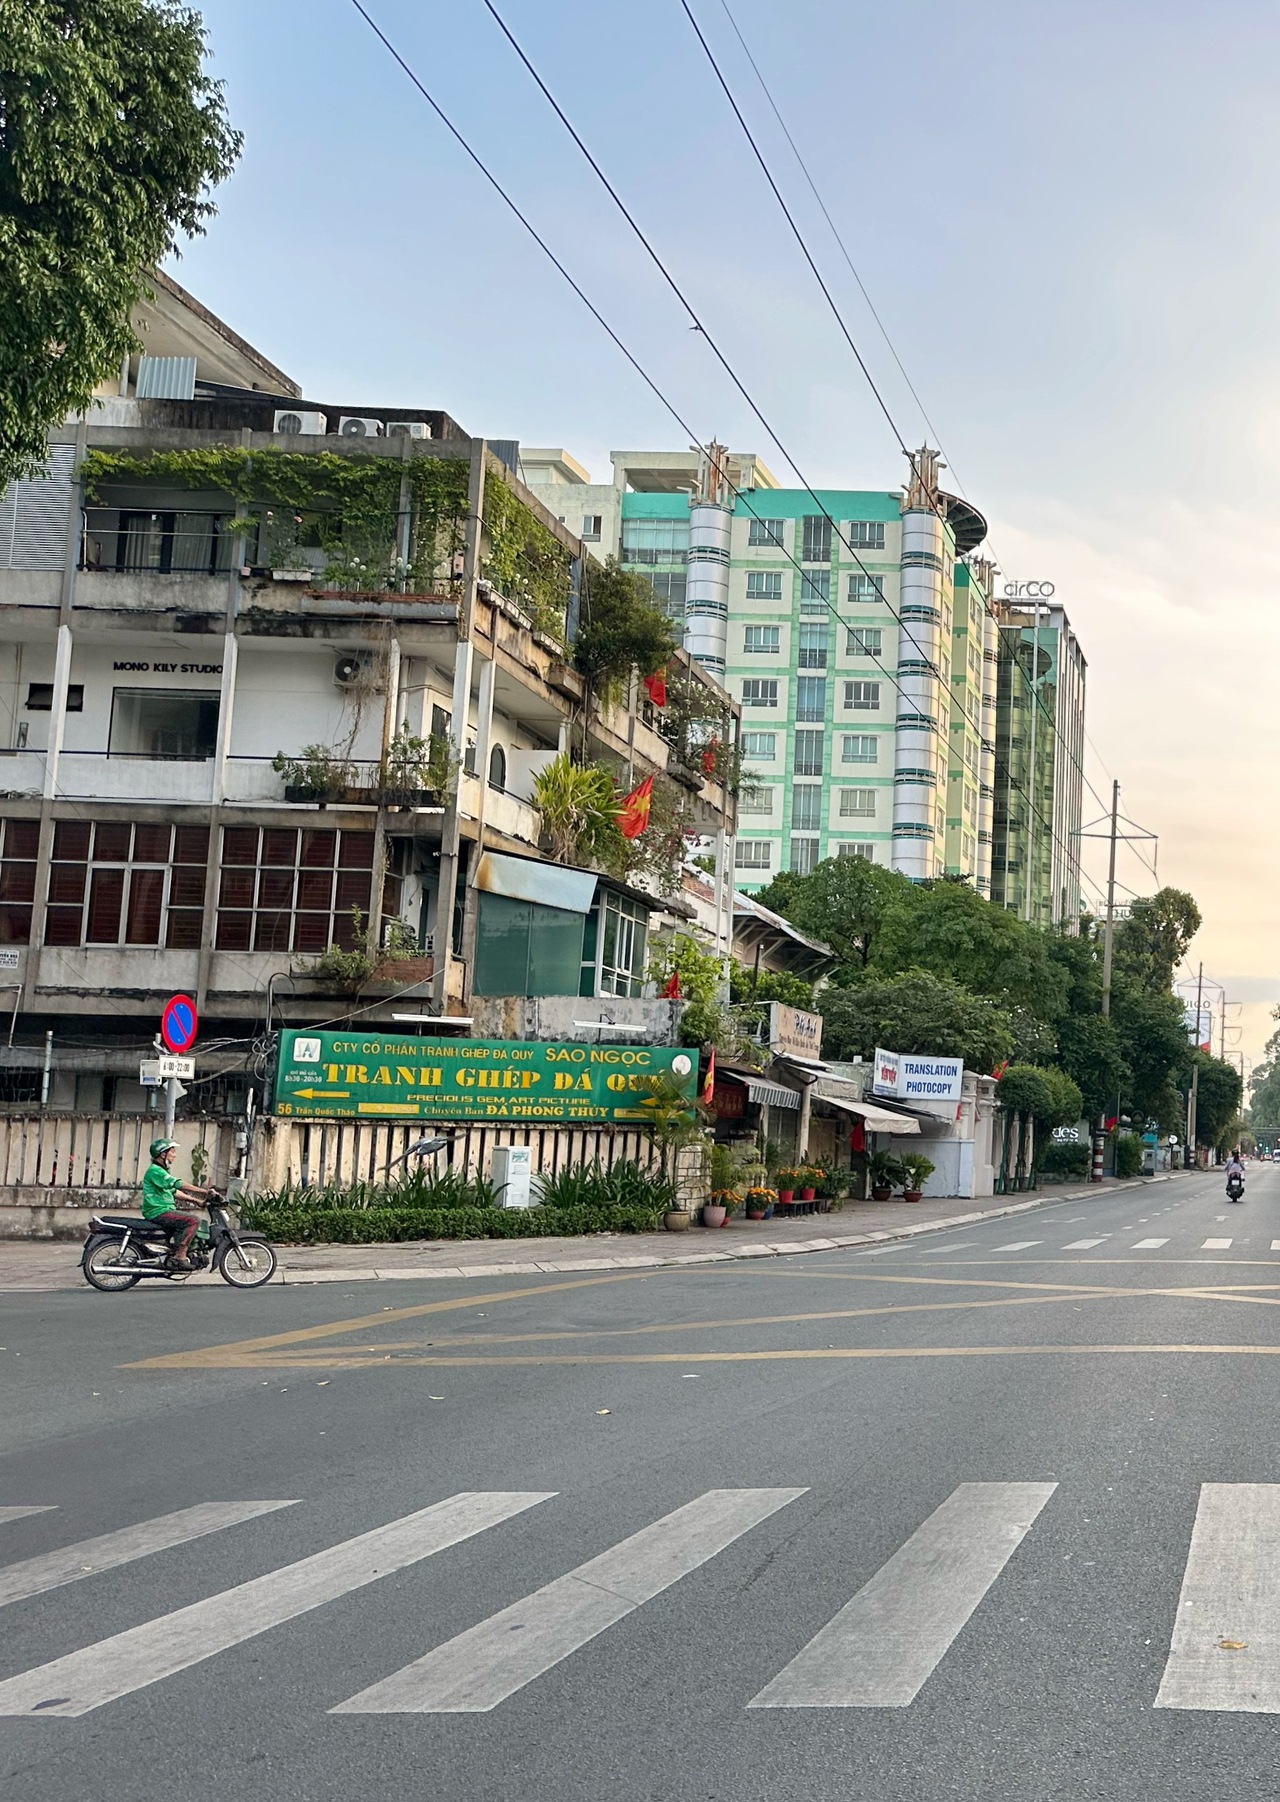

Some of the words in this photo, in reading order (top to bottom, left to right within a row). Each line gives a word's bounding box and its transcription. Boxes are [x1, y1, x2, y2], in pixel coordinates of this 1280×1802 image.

[113, 661, 149, 671] MONO
[153, 663, 178, 673] KILY
[181, 664, 223, 674] STUDIO
[333, 1041, 358, 1053] CTY
[362, 1037, 380, 1054] CỔ
[420, 1046, 458, 1058] TRANH
[461, 1045, 490, 1059] GHÉP
[493, 1045, 508, 1060] ĐÁ
[545, 1047, 586, 1063] SAO
[590, 1050, 651, 1068] NGỌC
[322, 1063, 443, 1086] TRANH
[455, 1065, 542, 1089] GHÉP
[553, 1068, 593, 1090] ĐÁ
[904, 1063, 958, 1077] TRANSLATION
[906, 1081, 952, 1094] PHOTOCOPY
[407, 1094, 473, 1103] PRECIOUS
[538, 1097, 590, 1105] PICTURE
[277, 1103, 293, 1114] 56
[424, 1106, 462, 1116] Chuyên
[486, 1102, 509, 1116] ĐÁ
[512, 1105, 564, 1117] PHONG
